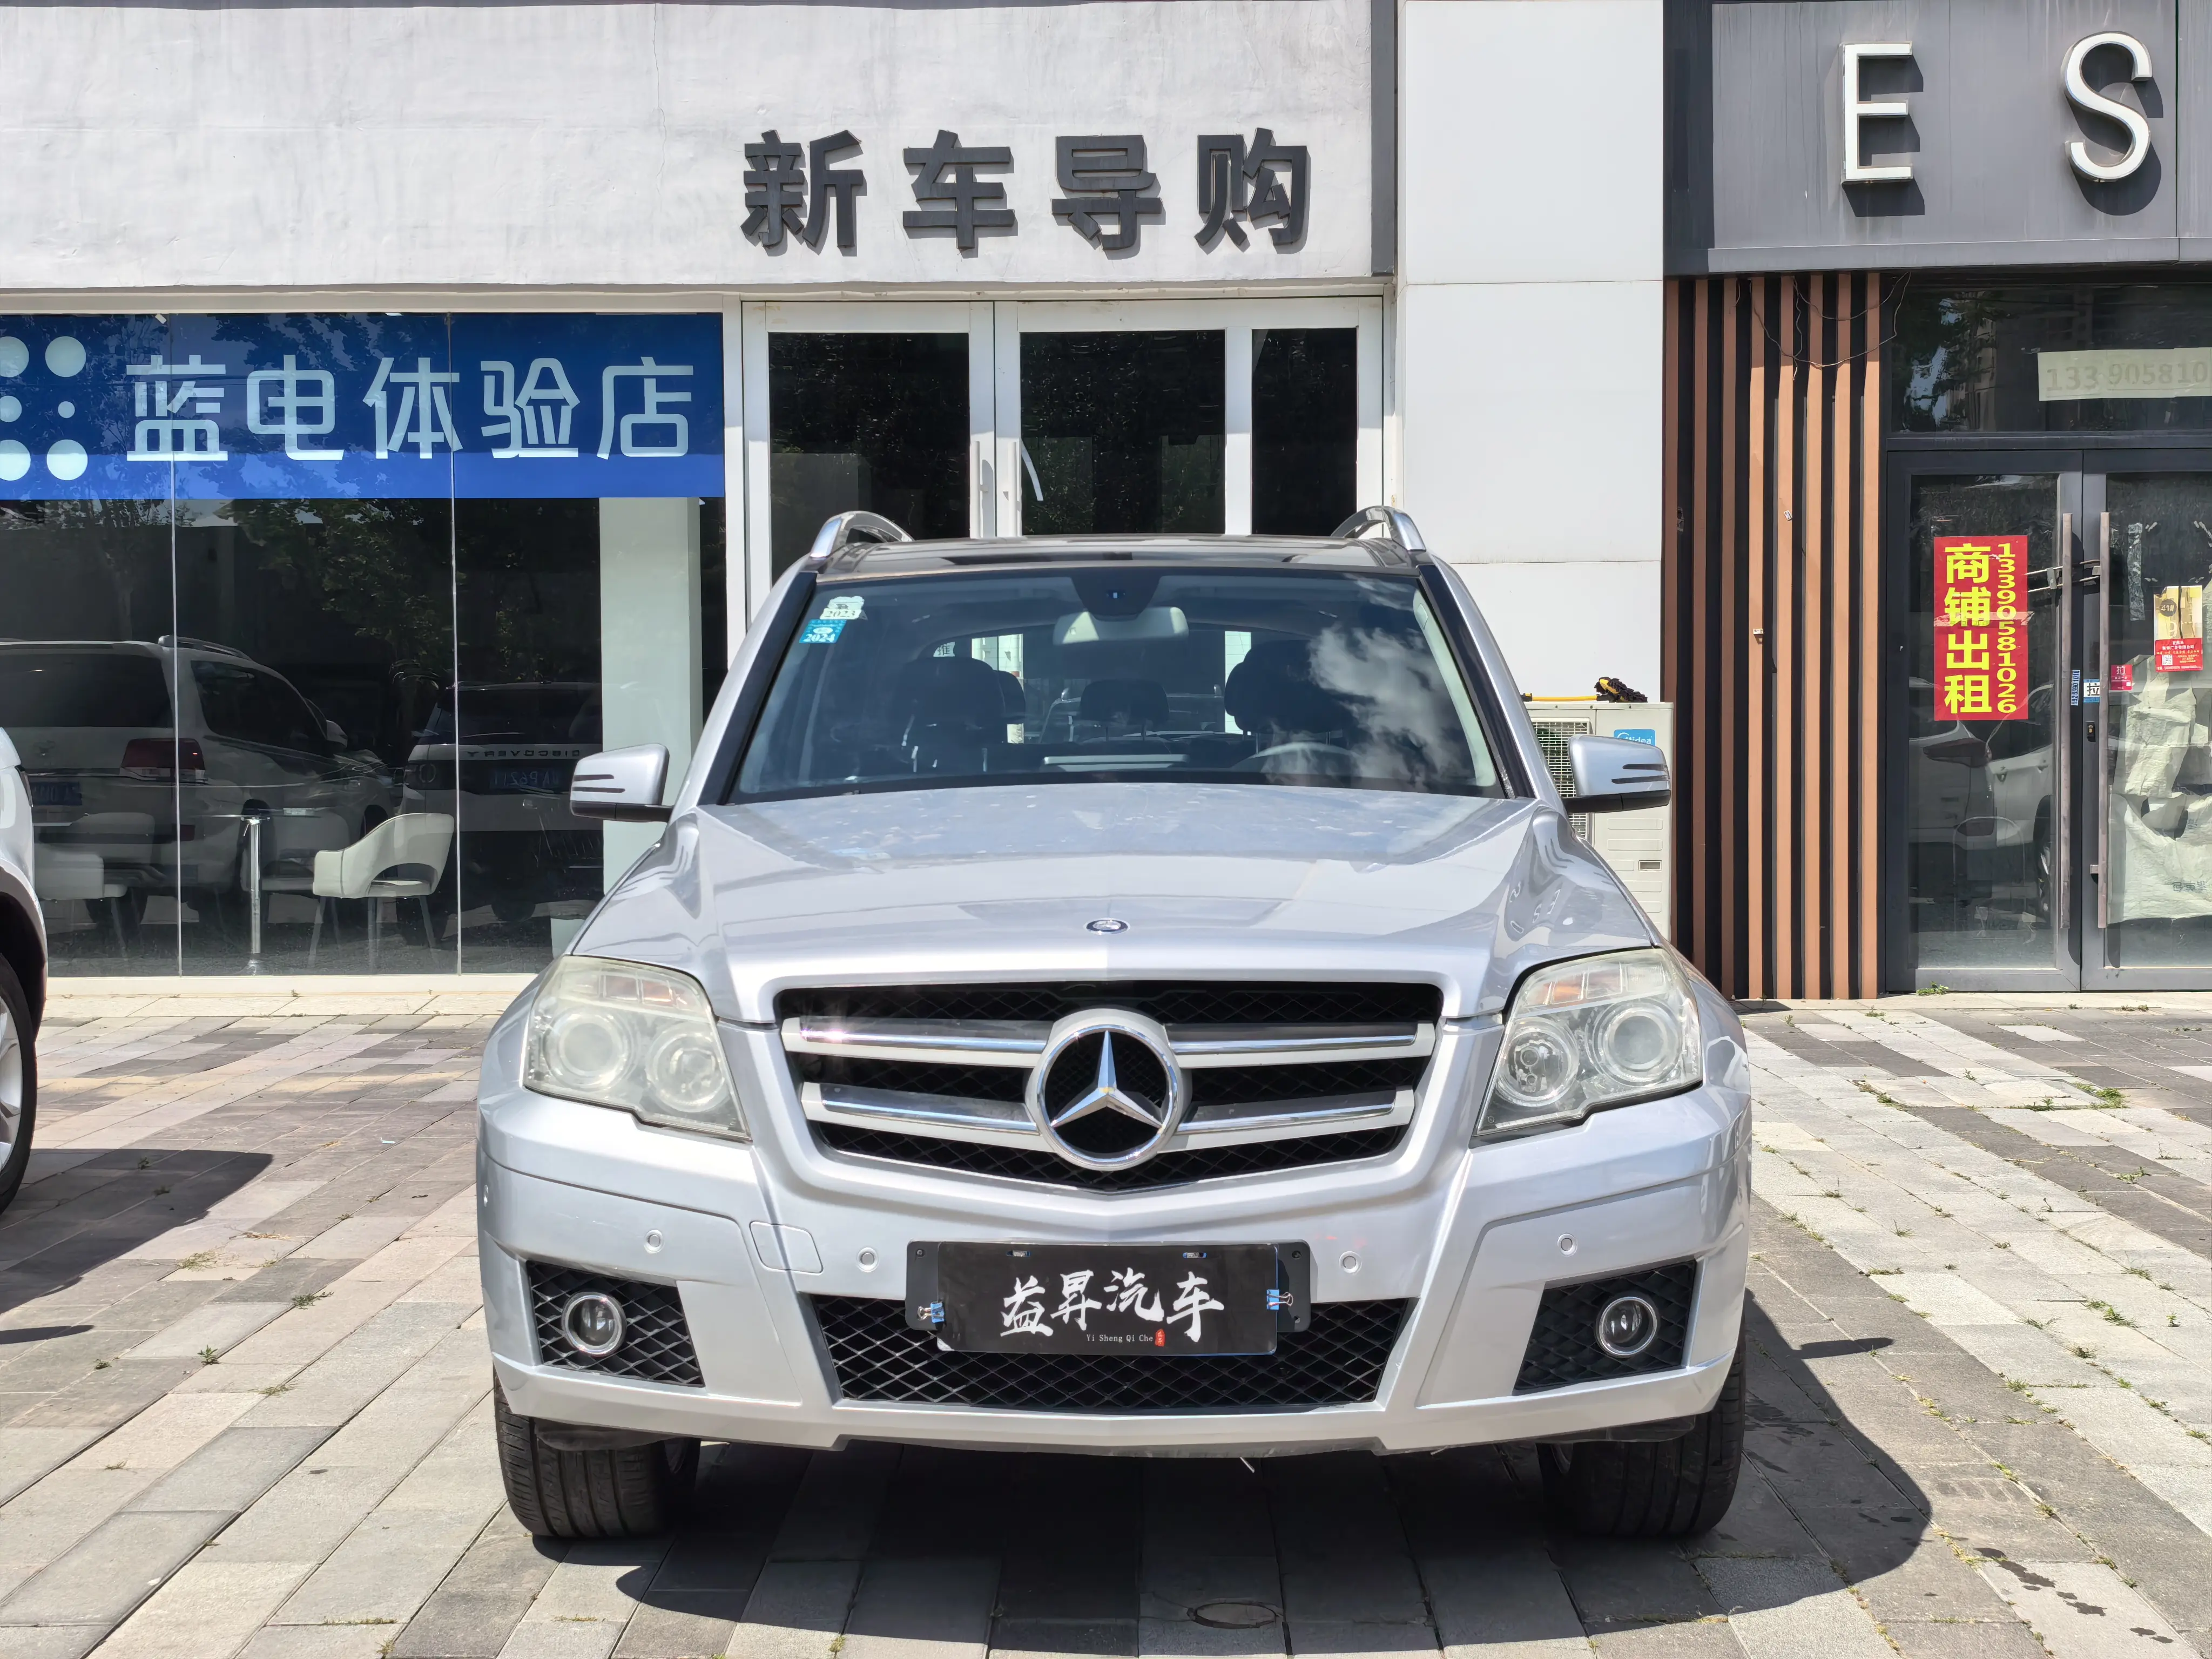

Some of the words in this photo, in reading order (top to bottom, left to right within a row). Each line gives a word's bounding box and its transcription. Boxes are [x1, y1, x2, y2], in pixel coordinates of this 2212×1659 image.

[740, 127, 1309, 251] 新车导购
[125, 354, 694, 461] 蓝电体验店
[1944, 543, 1992, 714] 商铺出租
[1997, 543, 2017, 713] 13390581026
[1000, 1267, 1225, 1343] 益昇汽车
[1099, 1334, 1123, 1343] Sheng
[1139, 1334, 1154, 1342] Che
